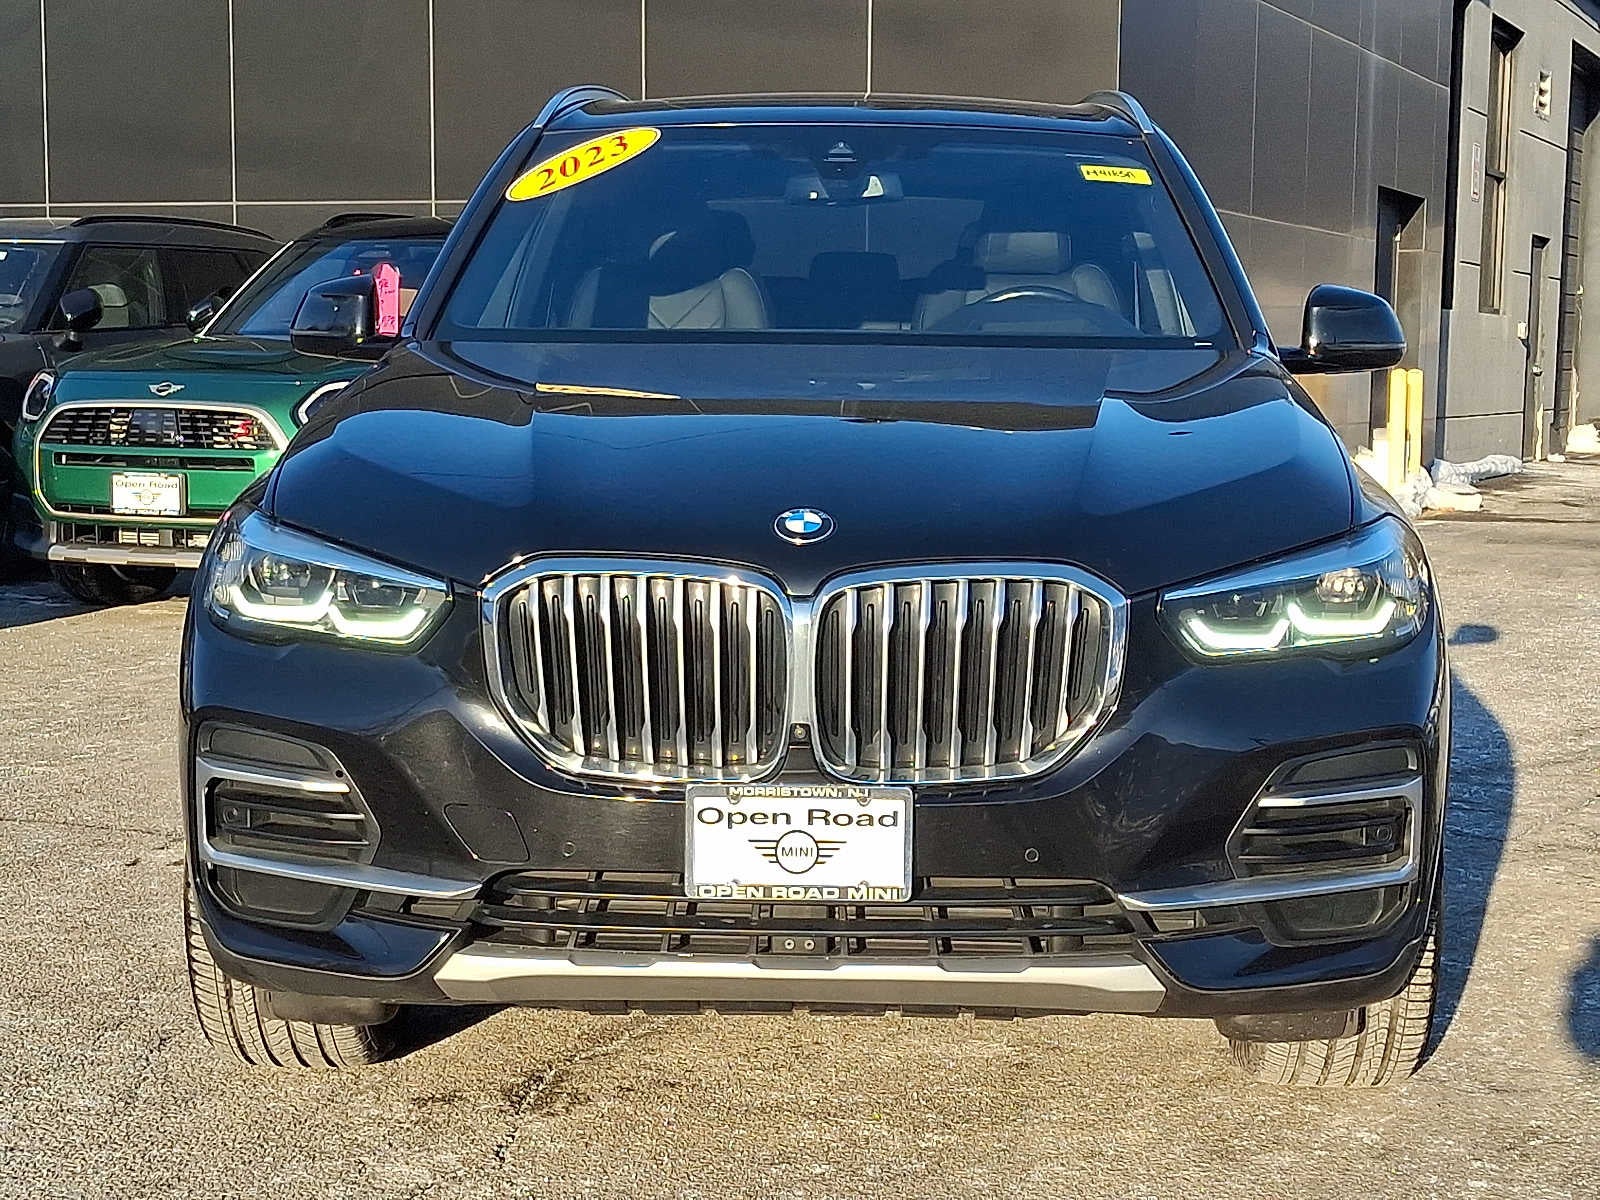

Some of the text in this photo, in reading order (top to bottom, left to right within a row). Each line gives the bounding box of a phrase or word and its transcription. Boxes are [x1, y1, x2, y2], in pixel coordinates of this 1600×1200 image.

[536, 135, 629, 191] 2023
[115, 480, 145, 488] Open
[729, 786, 869, 798] MORRISTOWN, NJ
[697, 807, 899, 829] Open Road
[781, 846, 814, 857] MINI
[700, 885, 899, 900] OPEN ROAD MINI
